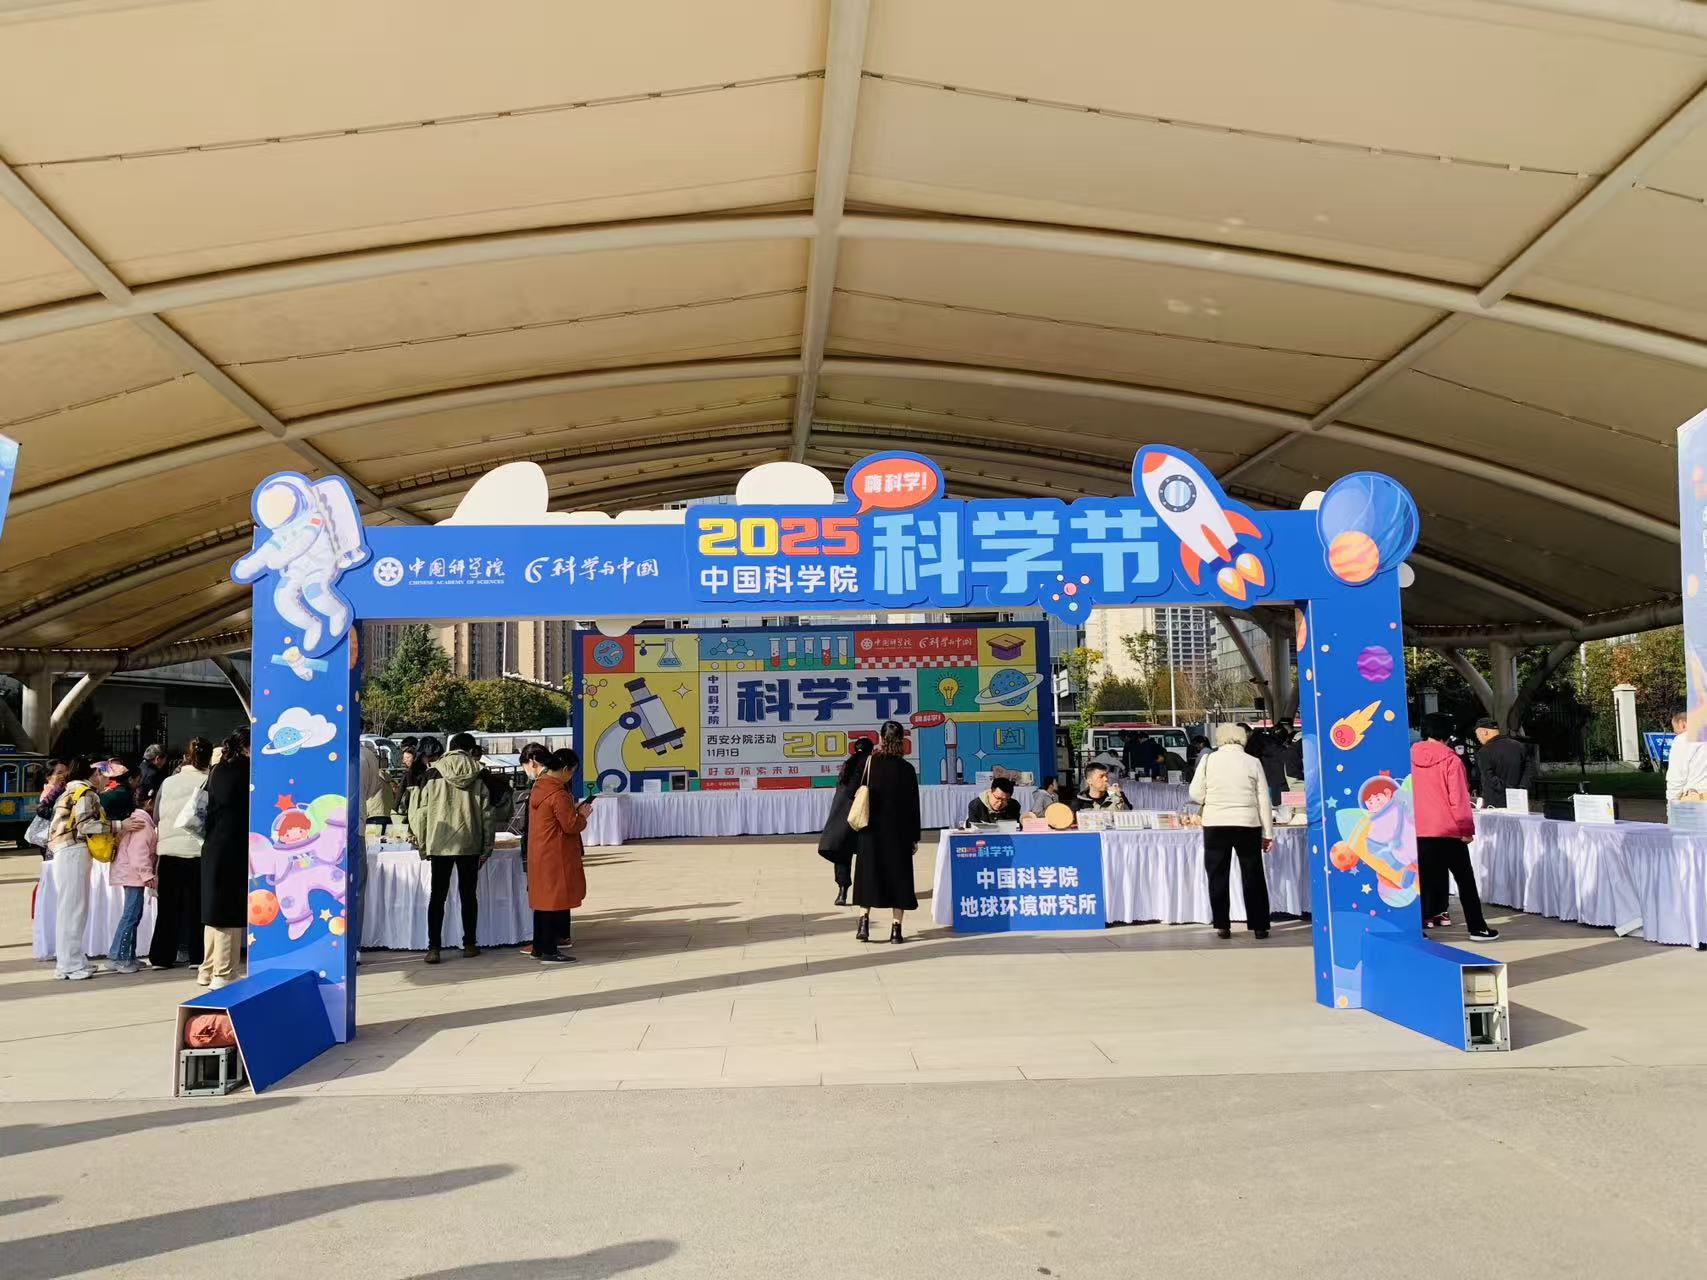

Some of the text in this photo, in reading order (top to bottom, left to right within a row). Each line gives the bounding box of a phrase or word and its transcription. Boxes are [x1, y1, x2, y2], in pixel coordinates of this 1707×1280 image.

[698, 517, 861, 556] 2025
[872, 509, 1161, 595] 科学节
[700, 564, 859, 594] 中国科学院
[707, 675, 720, 725] 中国科学院
[736, 676, 912, 723] 科学节
[706, 732, 777, 745] 西安分院活动
[706, 747, 740, 757] 11月1日
[707, 766, 799, 776] 好奇探索未知
[977, 846, 1014, 857] 科学节
[976, 866, 1079, 890] 中国科学院
[960, 893, 1097, 918] 地球环境研究所
